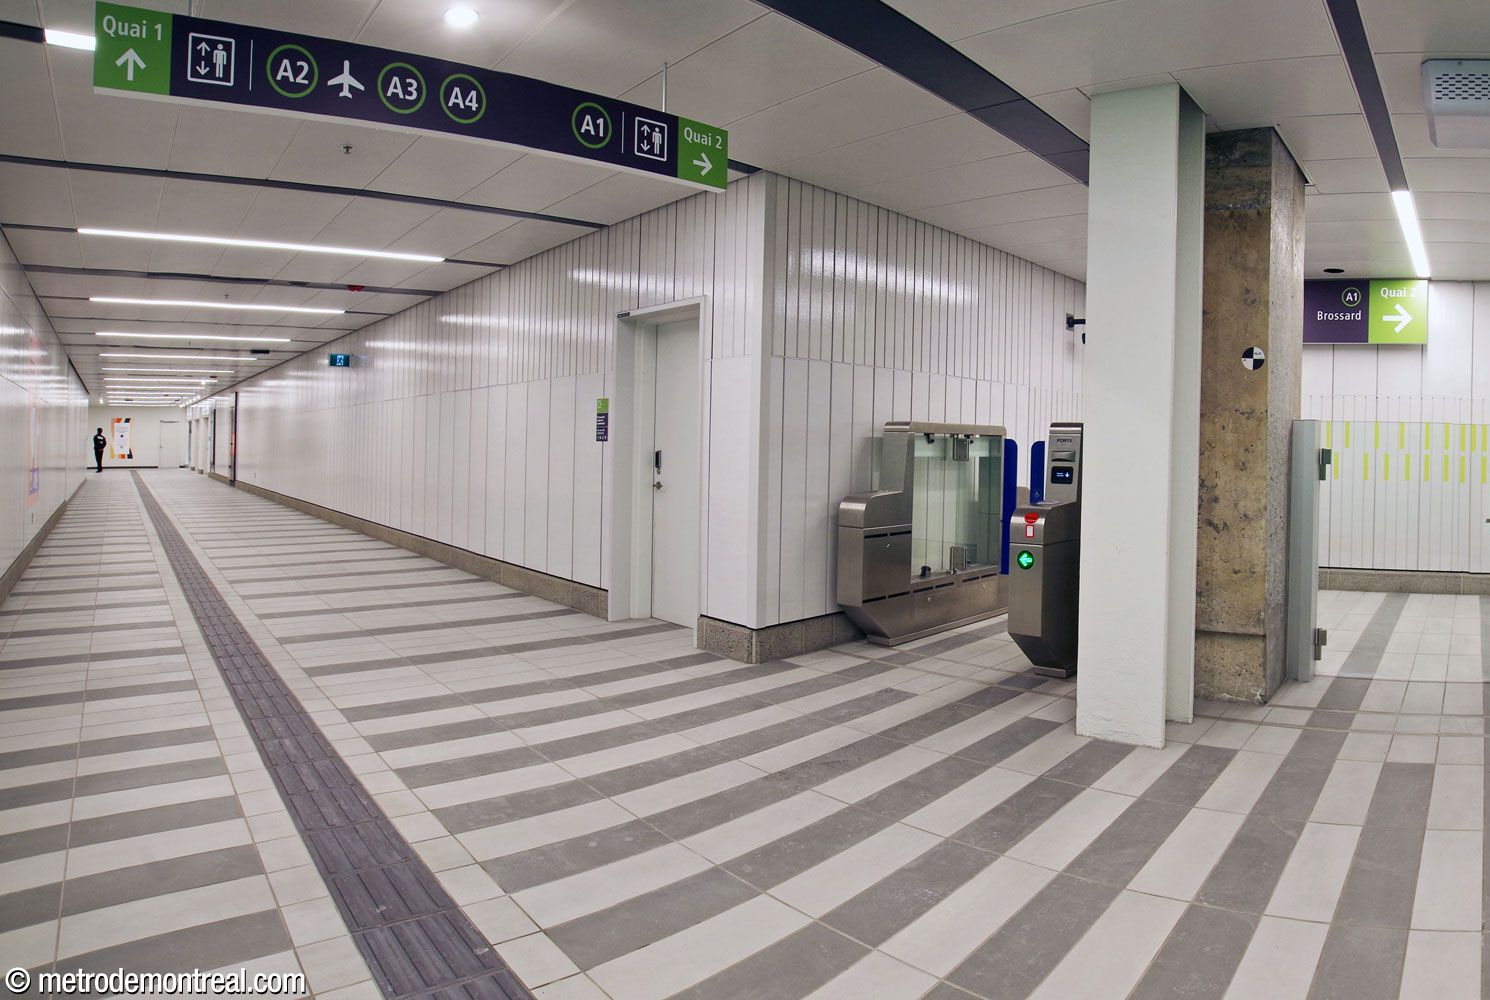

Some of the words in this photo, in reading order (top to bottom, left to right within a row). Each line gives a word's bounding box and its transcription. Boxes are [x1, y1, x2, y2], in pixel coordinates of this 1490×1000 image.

[103, 15, 147, 39] Quai
[155, 24, 162, 41] 1
[276, 58, 309, 85] A2
[386, 76, 418, 101] A3
[448, 87, 479, 111] A4
[581, 114, 604, 137] A1
[683, 126, 712, 147] Quai
[715, 135, 722, 149] 2
[1345, 292, 1358, 302] A1
[1380, 287, 1407, 299] Quai
[1410, 287, 1417, 297] 2
[1317, 310, 1361, 321] Brossard
